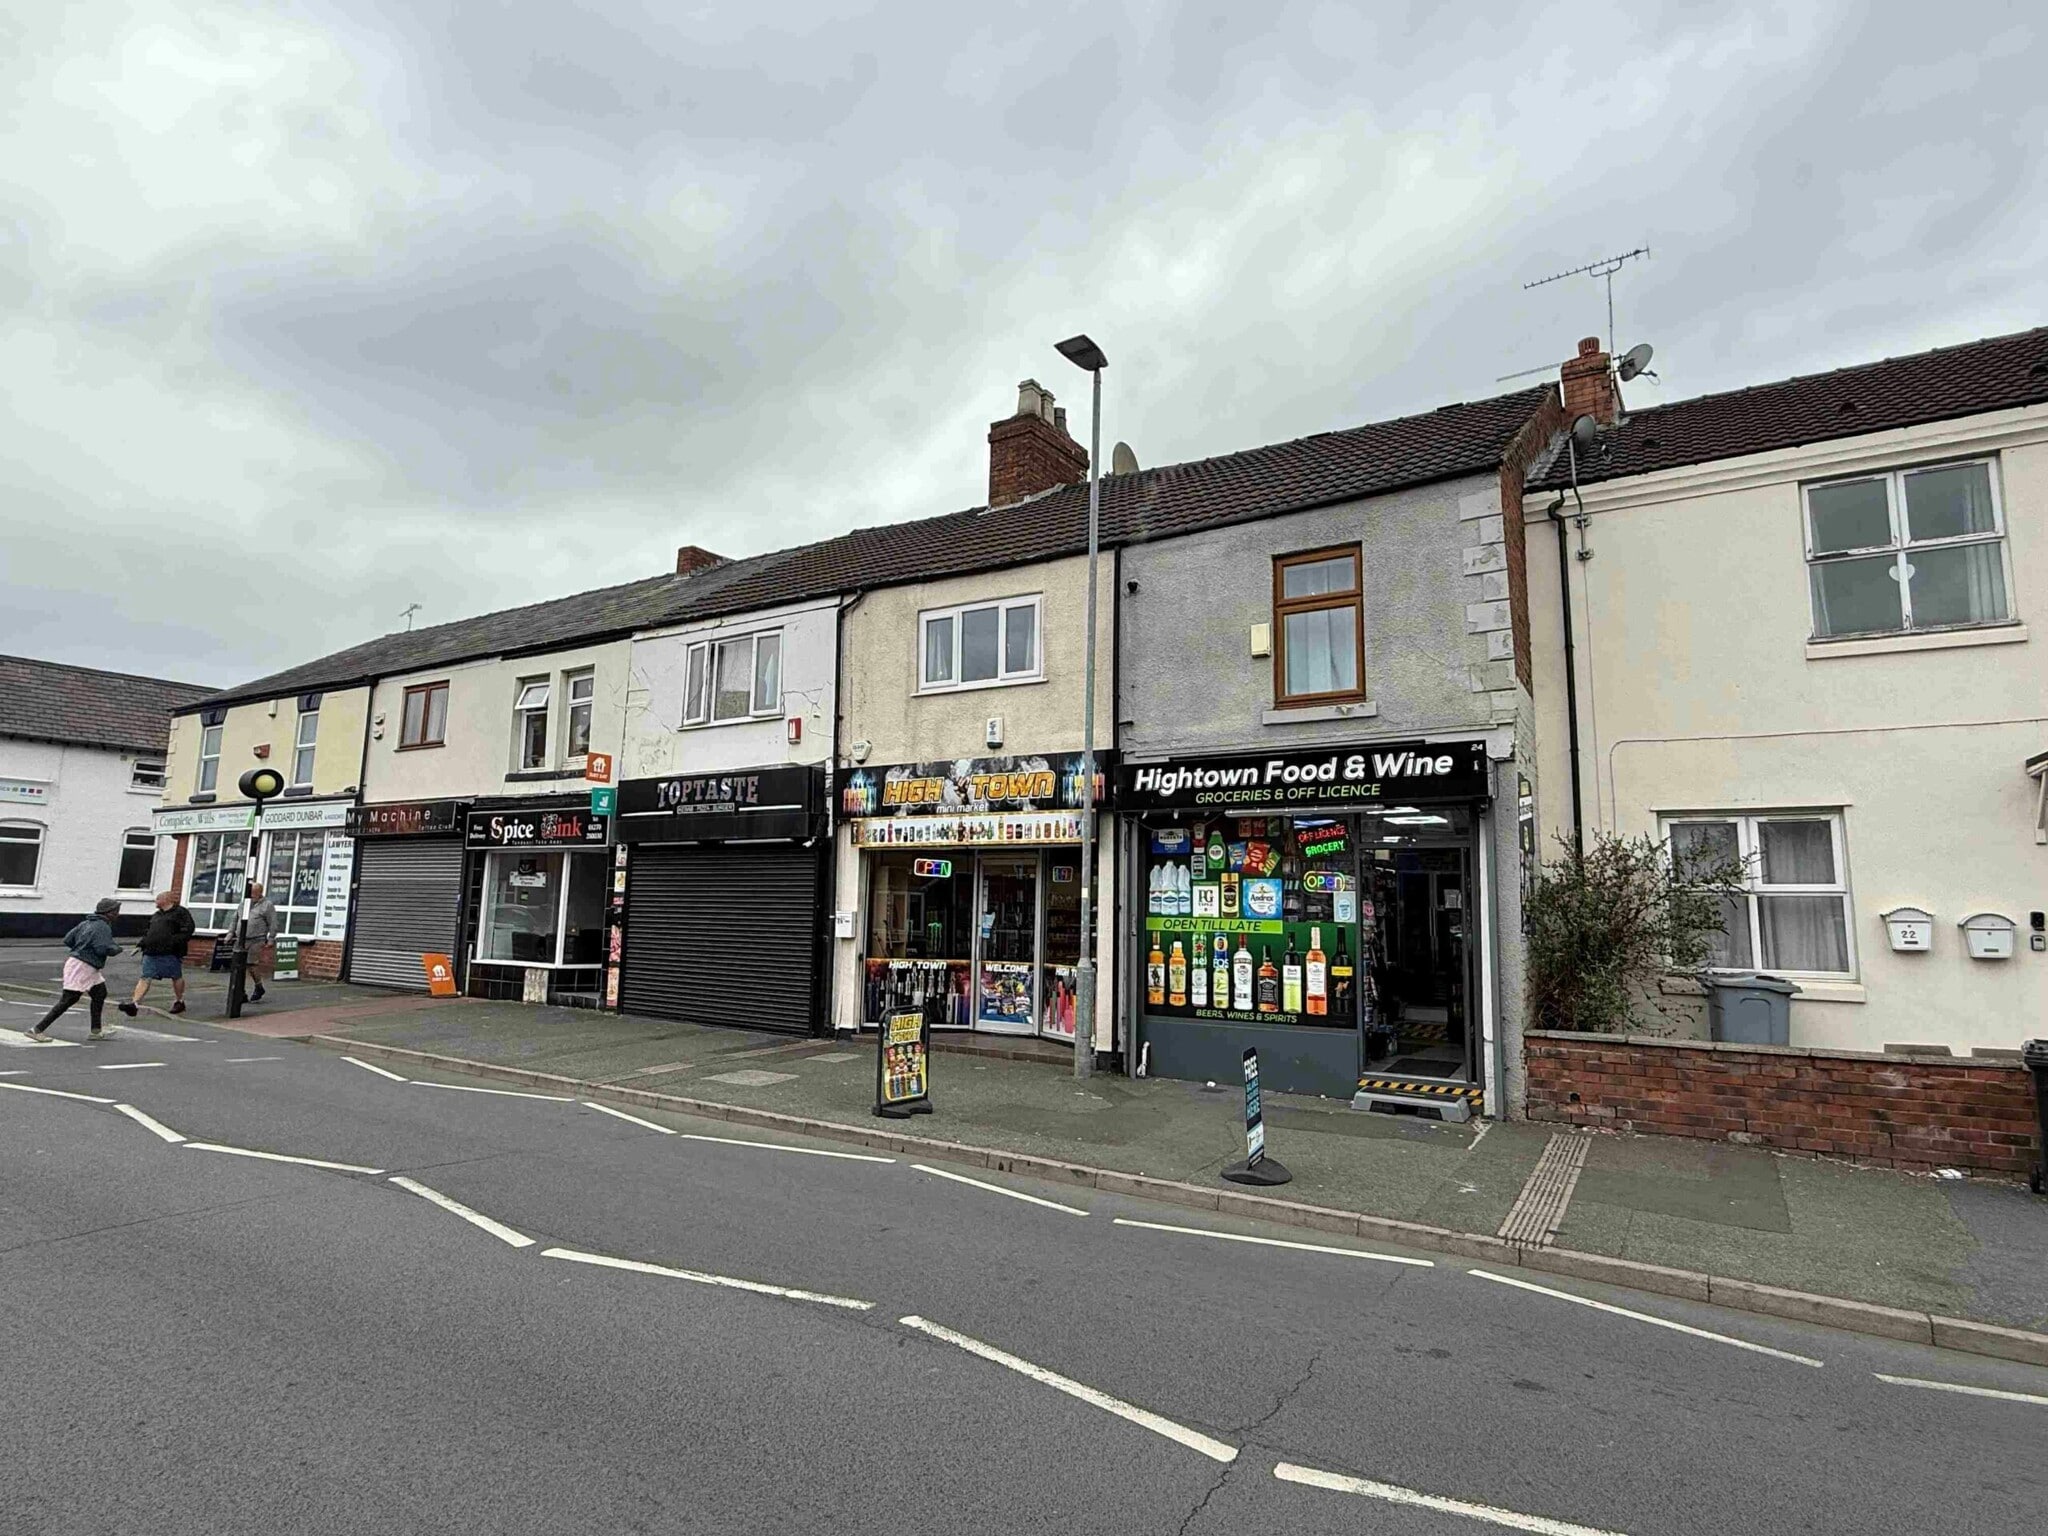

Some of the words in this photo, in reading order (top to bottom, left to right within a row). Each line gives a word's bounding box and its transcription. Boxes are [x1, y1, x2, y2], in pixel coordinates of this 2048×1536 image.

[1134, 767, 1258, 797] Hightown
[1263, 756, 1338, 784] Food
[1343, 754, 1366, 781] &
[1372, 752, 1453, 779] Wine
[657, 776, 759, 808] TOPTASTE
[882, 777, 944, 806] HIGH
[1196, 789, 1271, 803] GROCERIES
[1274, 788, 1283, 800] &
[1287, 786, 1316, 799] OFF
[1318, 784, 1381, 799] LICENCE
[936, 804, 955, 814] mini
[956, 801, 988, 812] market
[265, 812, 296, 823] GODDARD
[297, 810, 323, 821] DUNBAR
[370, 809, 431, 823] Machine
[490, 816, 534, 844] Spice
[1305, 840, 1345, 856] GROCERY
[1163, 919, 1197, 930] OPEN
[1201, 920, 1225, 931] TILL
[1228, 921, 1262, 932] LATE
[1901, 930, 1917, 938] 22
[888, 961, 912, 969] HIGH
[985, 963, 1028, 973] WELCOME
[1195, 1009, 1224, 1018] BEERS,
[1227, 1011, 1254, 1020] WINES
[1264, 1013, 1297, 1023] SPIRITS
[891, 1016, 921, 1031] HIGH
